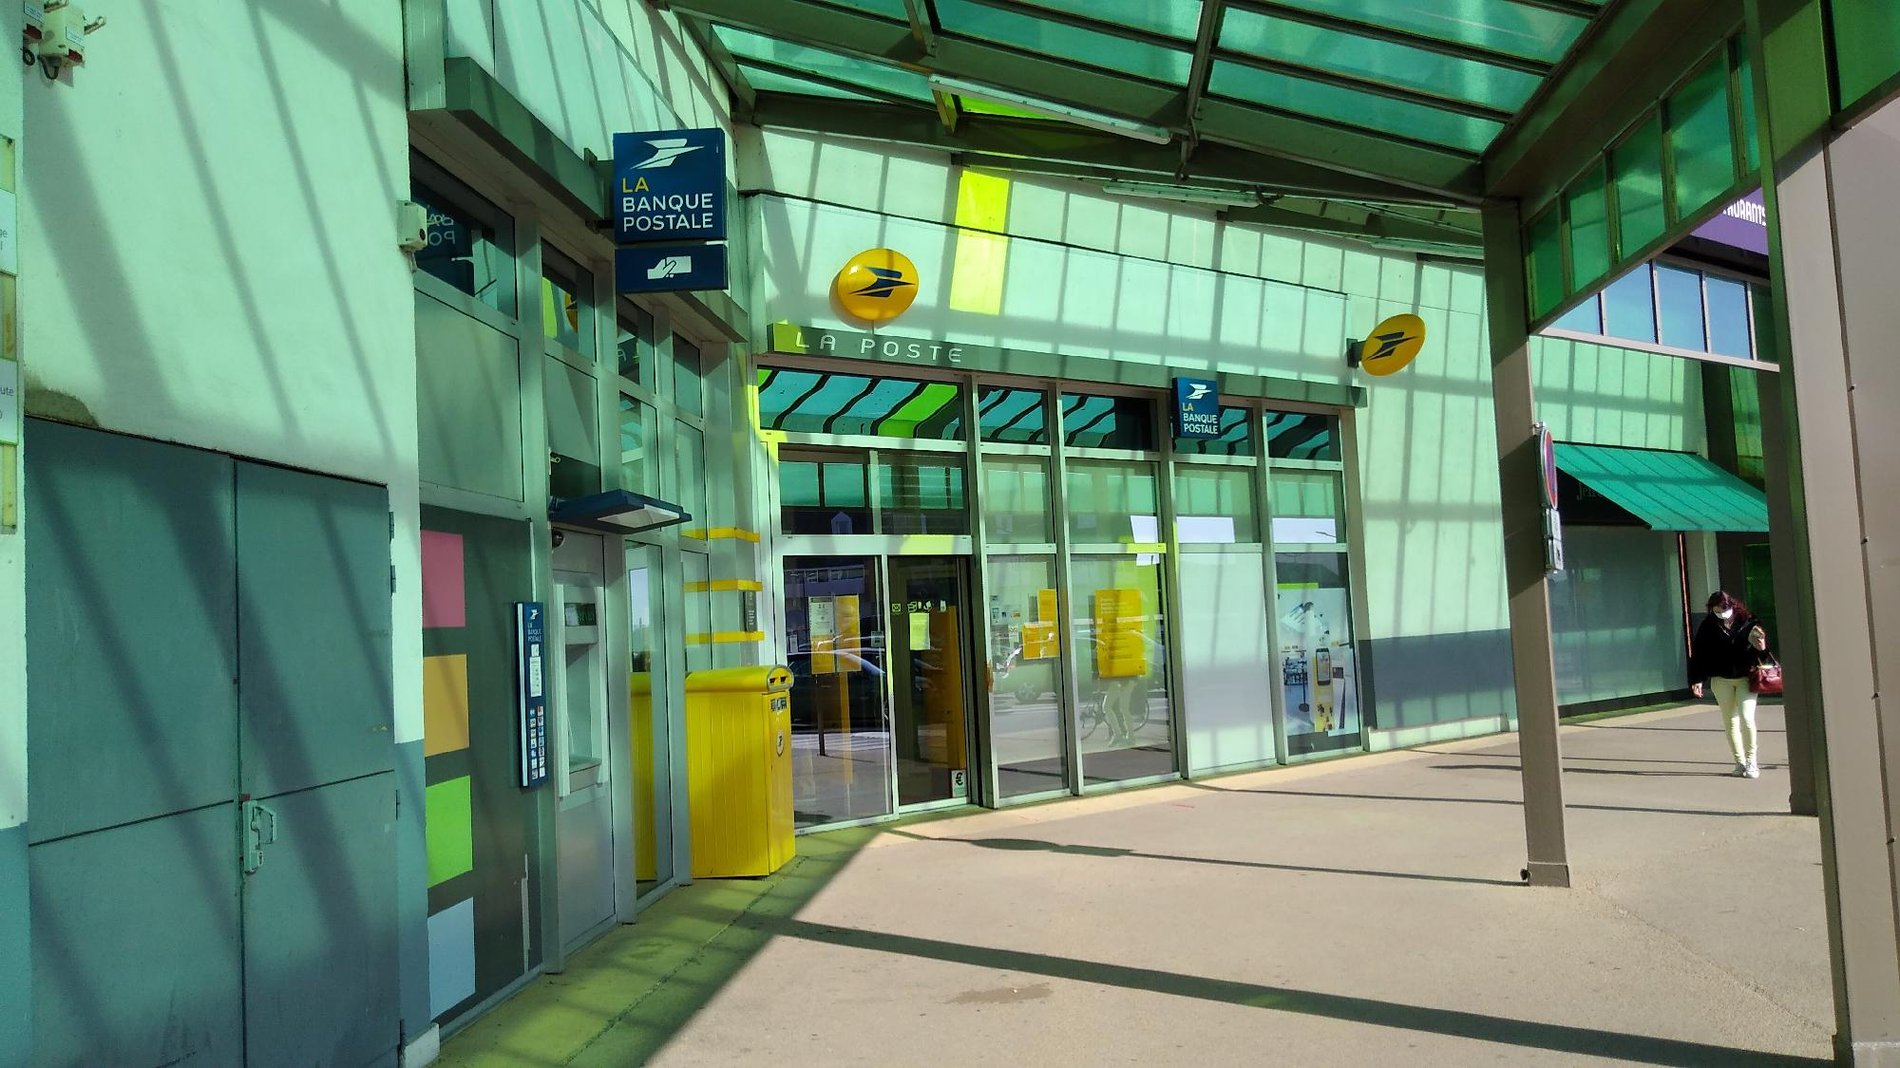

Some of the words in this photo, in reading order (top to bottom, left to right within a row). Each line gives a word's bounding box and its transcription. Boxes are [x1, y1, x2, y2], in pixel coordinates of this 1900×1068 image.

[622, 176, 649, 193] LA
[622, 193, 713, 213] BANQUE
[623, 212, 713, 232] POSTALE
[796, 331, 836, 351] LA
[860, 338, 962, 363] POSTE
[1182, 402, 1194, 412] LA
[1183, 413, 1218, 424] BANQUE
[1183, 423, 1219, 435] POSTALE
